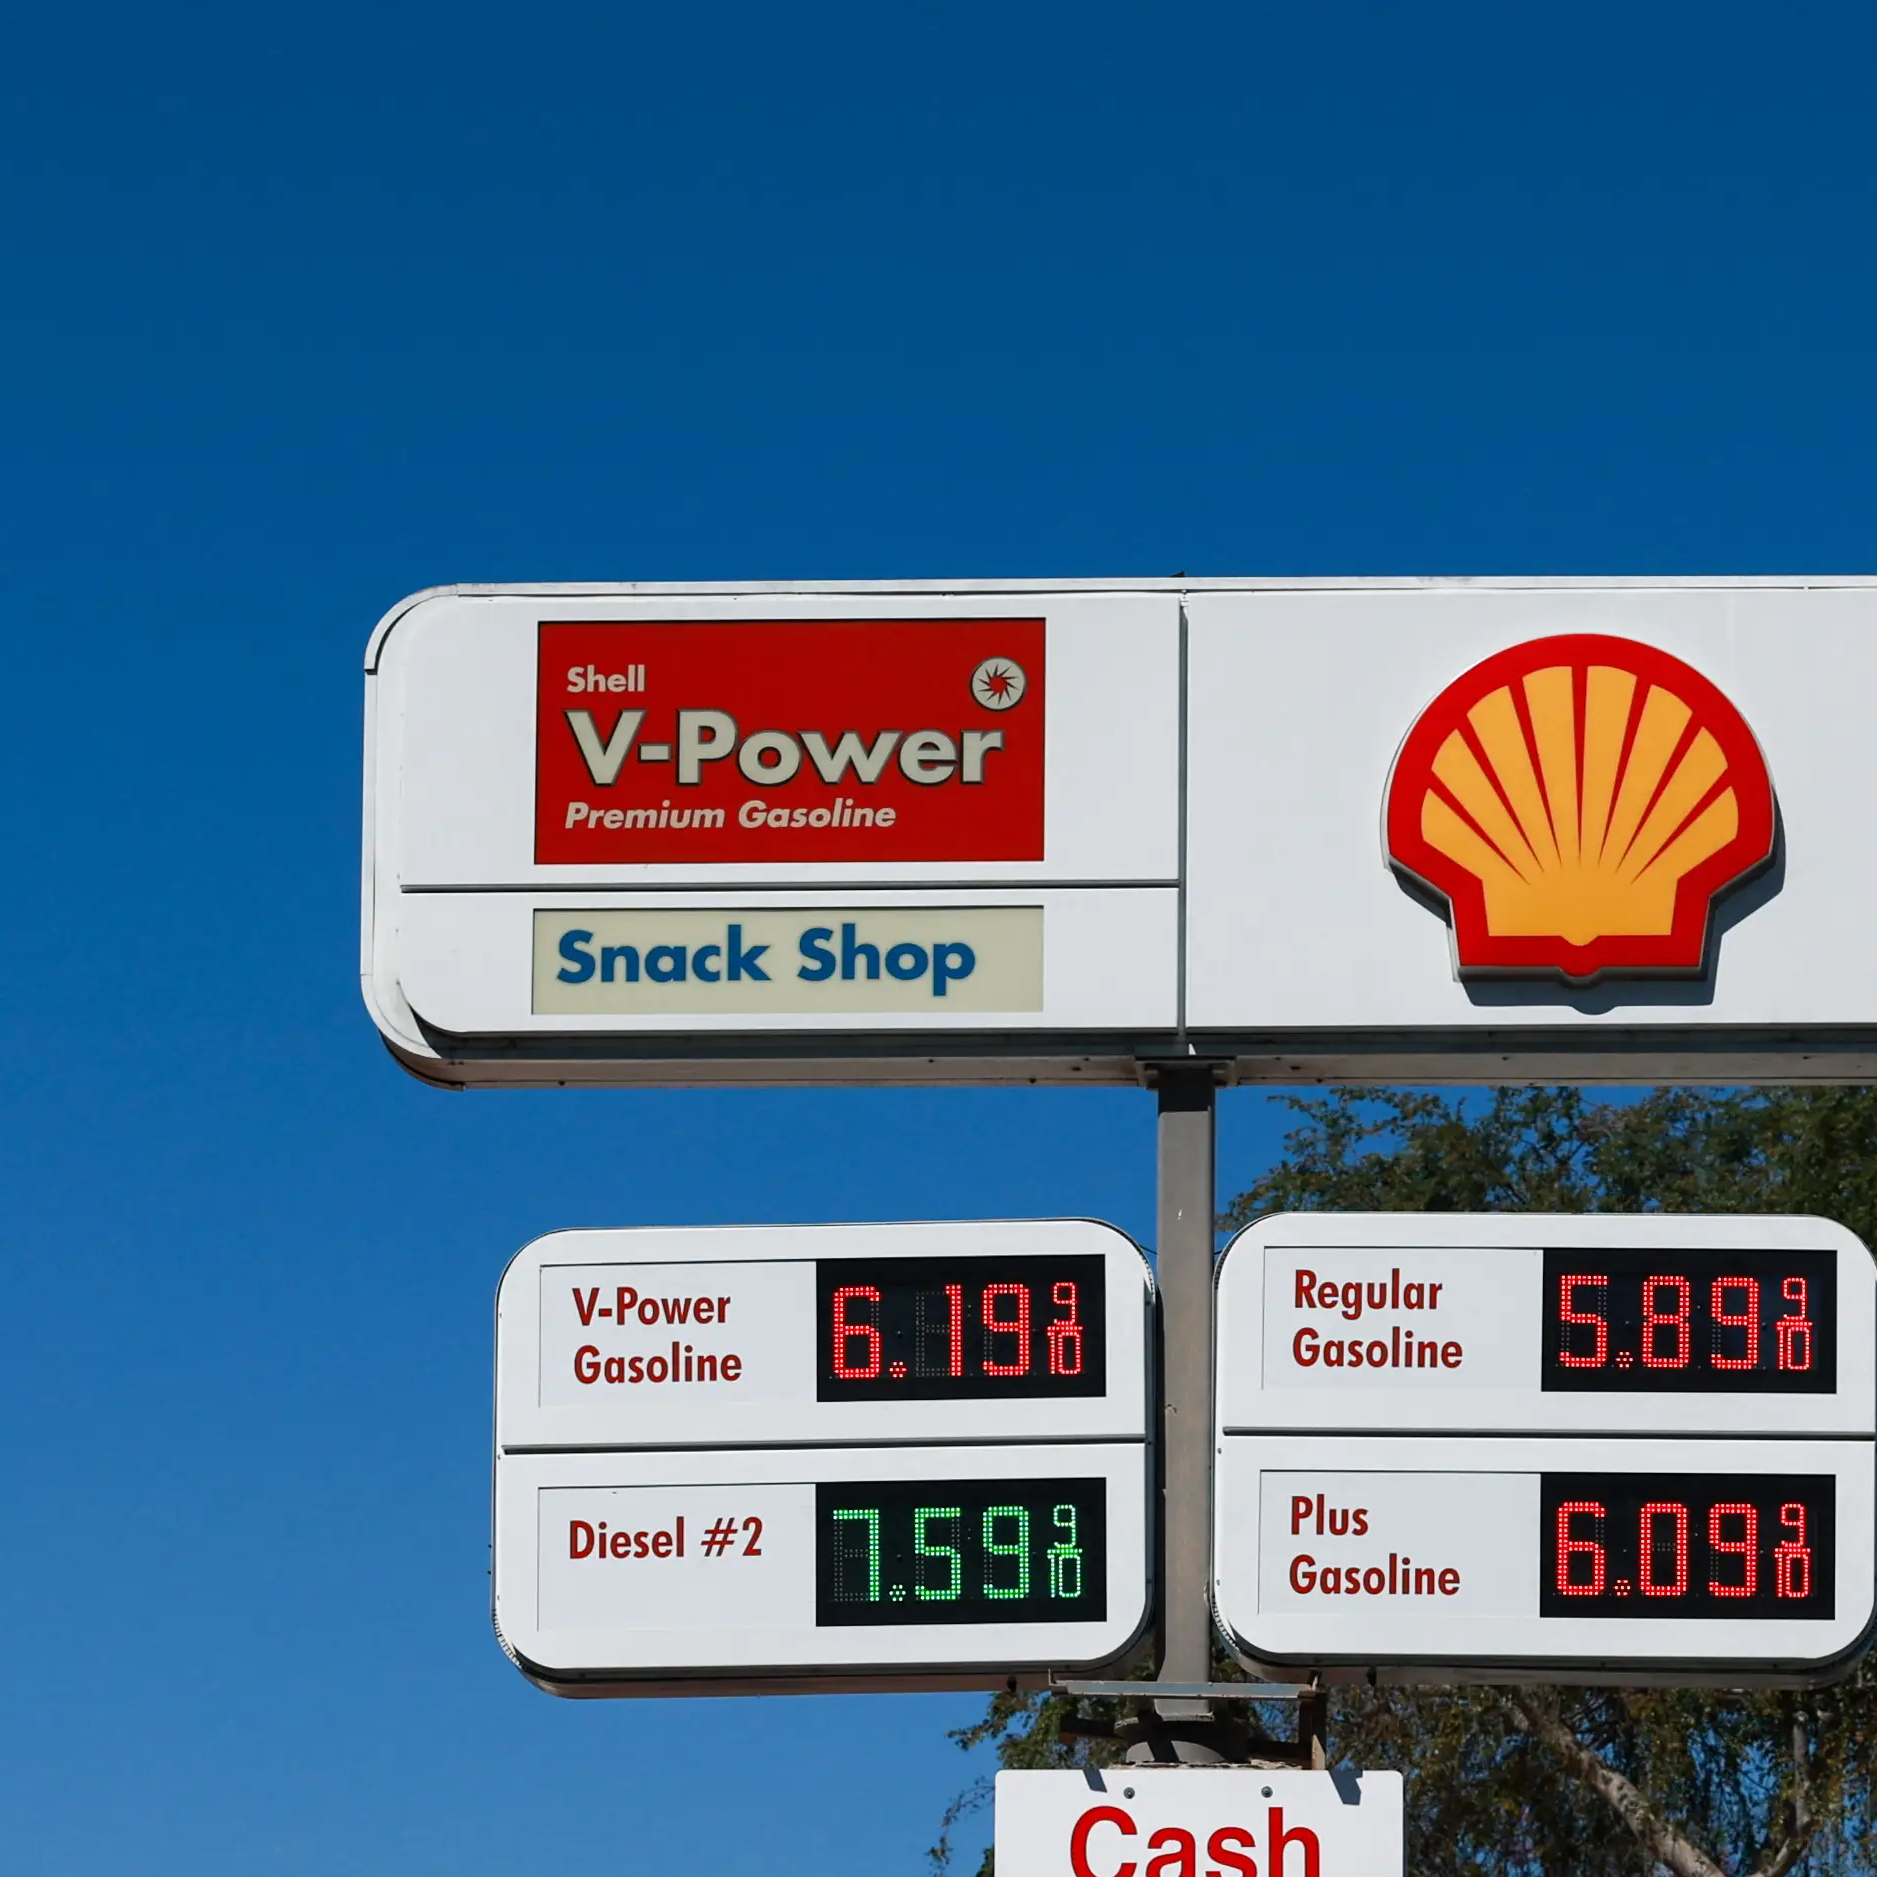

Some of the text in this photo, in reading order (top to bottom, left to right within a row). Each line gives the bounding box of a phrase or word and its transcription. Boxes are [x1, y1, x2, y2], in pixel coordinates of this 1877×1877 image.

[567, 664, 645, 693] Shell
[566, 708, 1003, 787] V-Power
[565, 797, 896, 829] Premium Gasoline
[557, 923, 976, 997] Snack Shop
[573, 1286, 731, 1327] V-Power
[1294, 1269, 1443, 1321] Regular
[832, 1283, 1032, 1380] 6.19
[1558, 1274, 1761, 1370] 5.89
[574, 1342, 742, 1385] Gasoline
[1293, 1327, 1463, 1370] Gasoline
[1291, 1494, 1370, 1537] Plus
[569, 1516, 764, 1561] Diesel #2
[833, 1505, 1030, 1602] 7.59
[1556, 1501, 1759, 1598] 6.09
[1289, 1554, 1461, 1598] Gasoline
